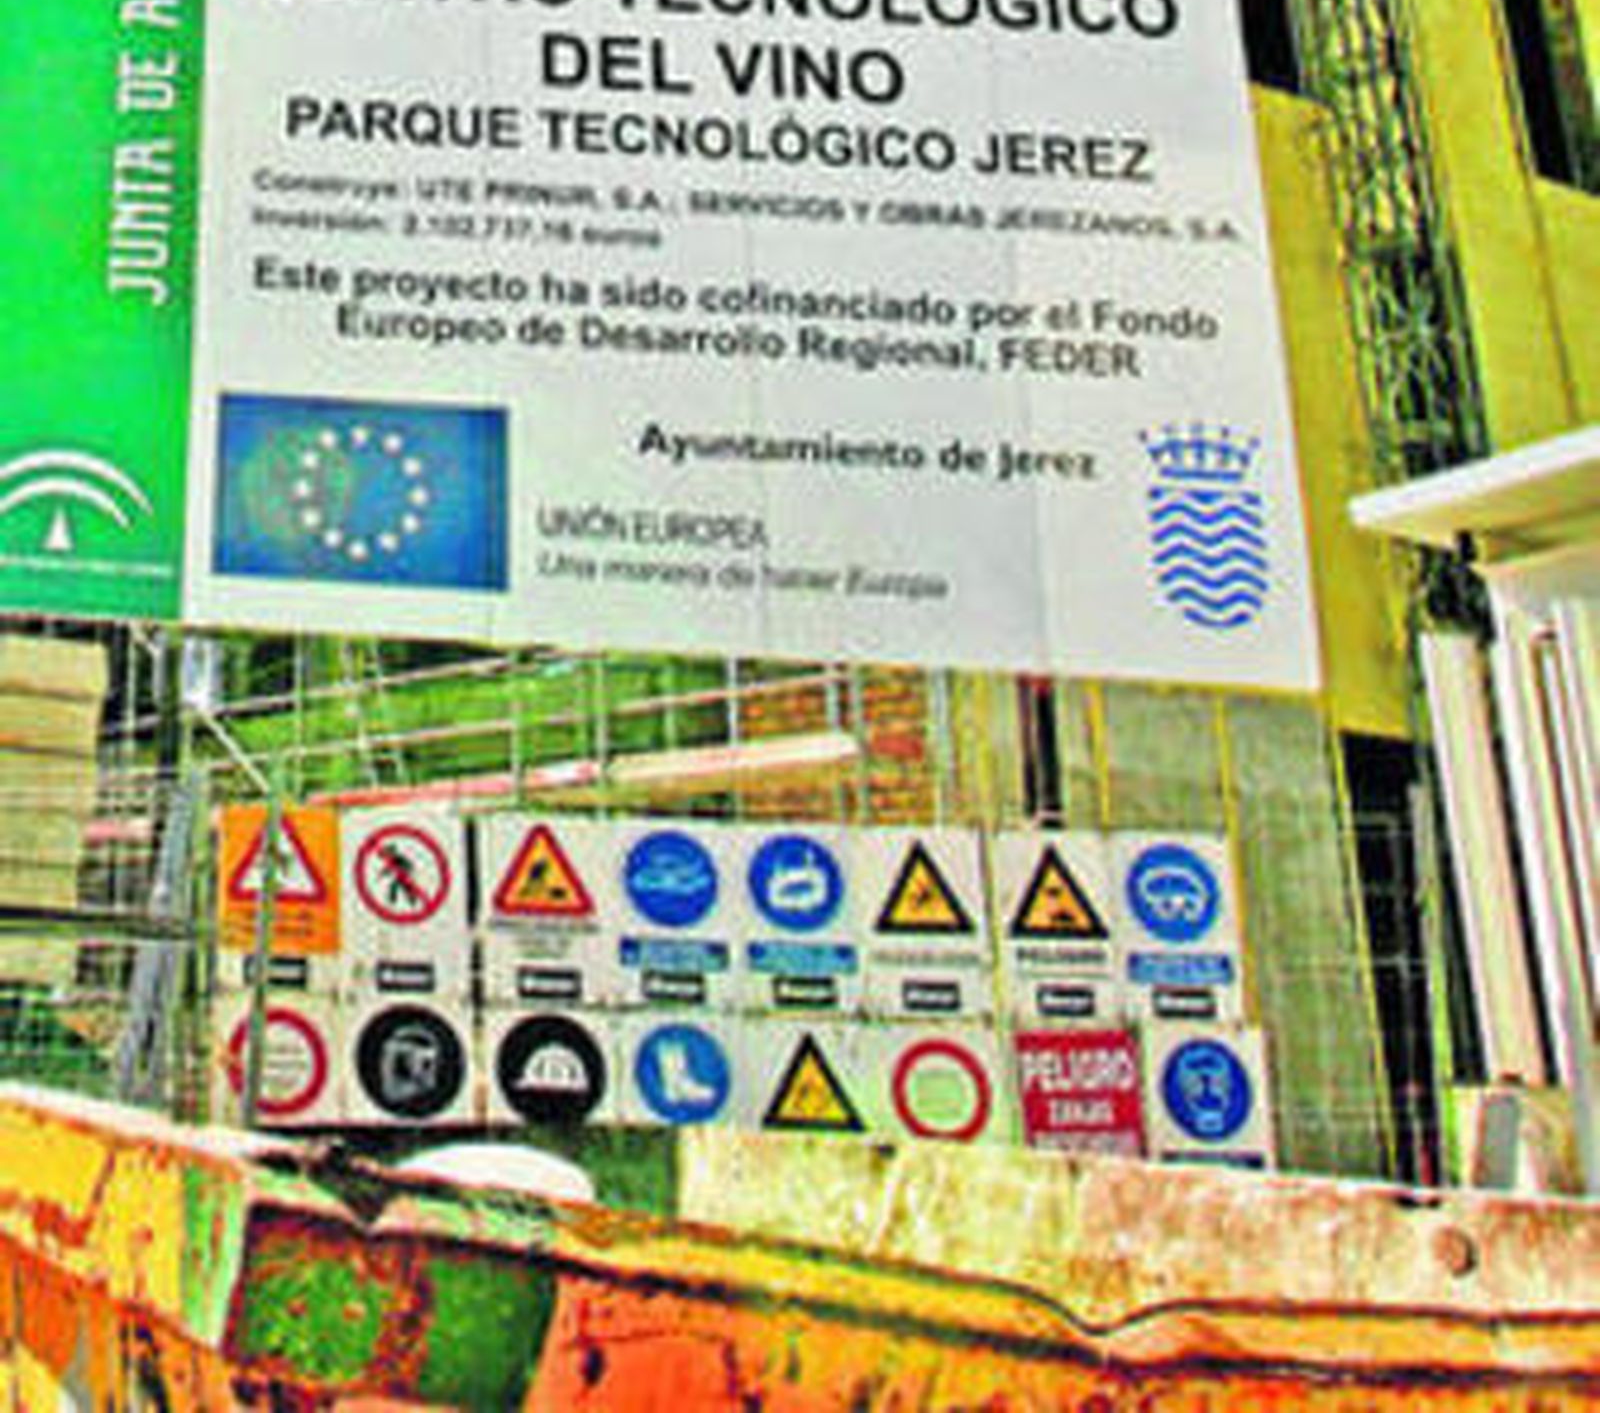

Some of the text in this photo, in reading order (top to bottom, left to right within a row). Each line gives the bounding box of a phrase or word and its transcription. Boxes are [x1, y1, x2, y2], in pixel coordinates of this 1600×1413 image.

[117, 52, 176, 112] DE
[541, 33, 904, 104] DEL VINO
[286, 97, 1152, 182] PARQUE TECNOLÓGICO JEREZ
[108, 138, 176, 306] JUNTA
[253, 257, 1219, 340] Este proyecto ha sido cofinanciado por el Fondo
[338, 304, 508, 346] Europeo
[517, 316, 565, 346] de
[580, 316, 786, 359] Desarrollo
[998, 337, 1141, 377] FEDER
[638, 422, 1098, 481] Ayuntamiento de Jerez
[633, 510, 769, 550] EUROPEA
[1019, 1049, 1137, 1093] PELIGRO
